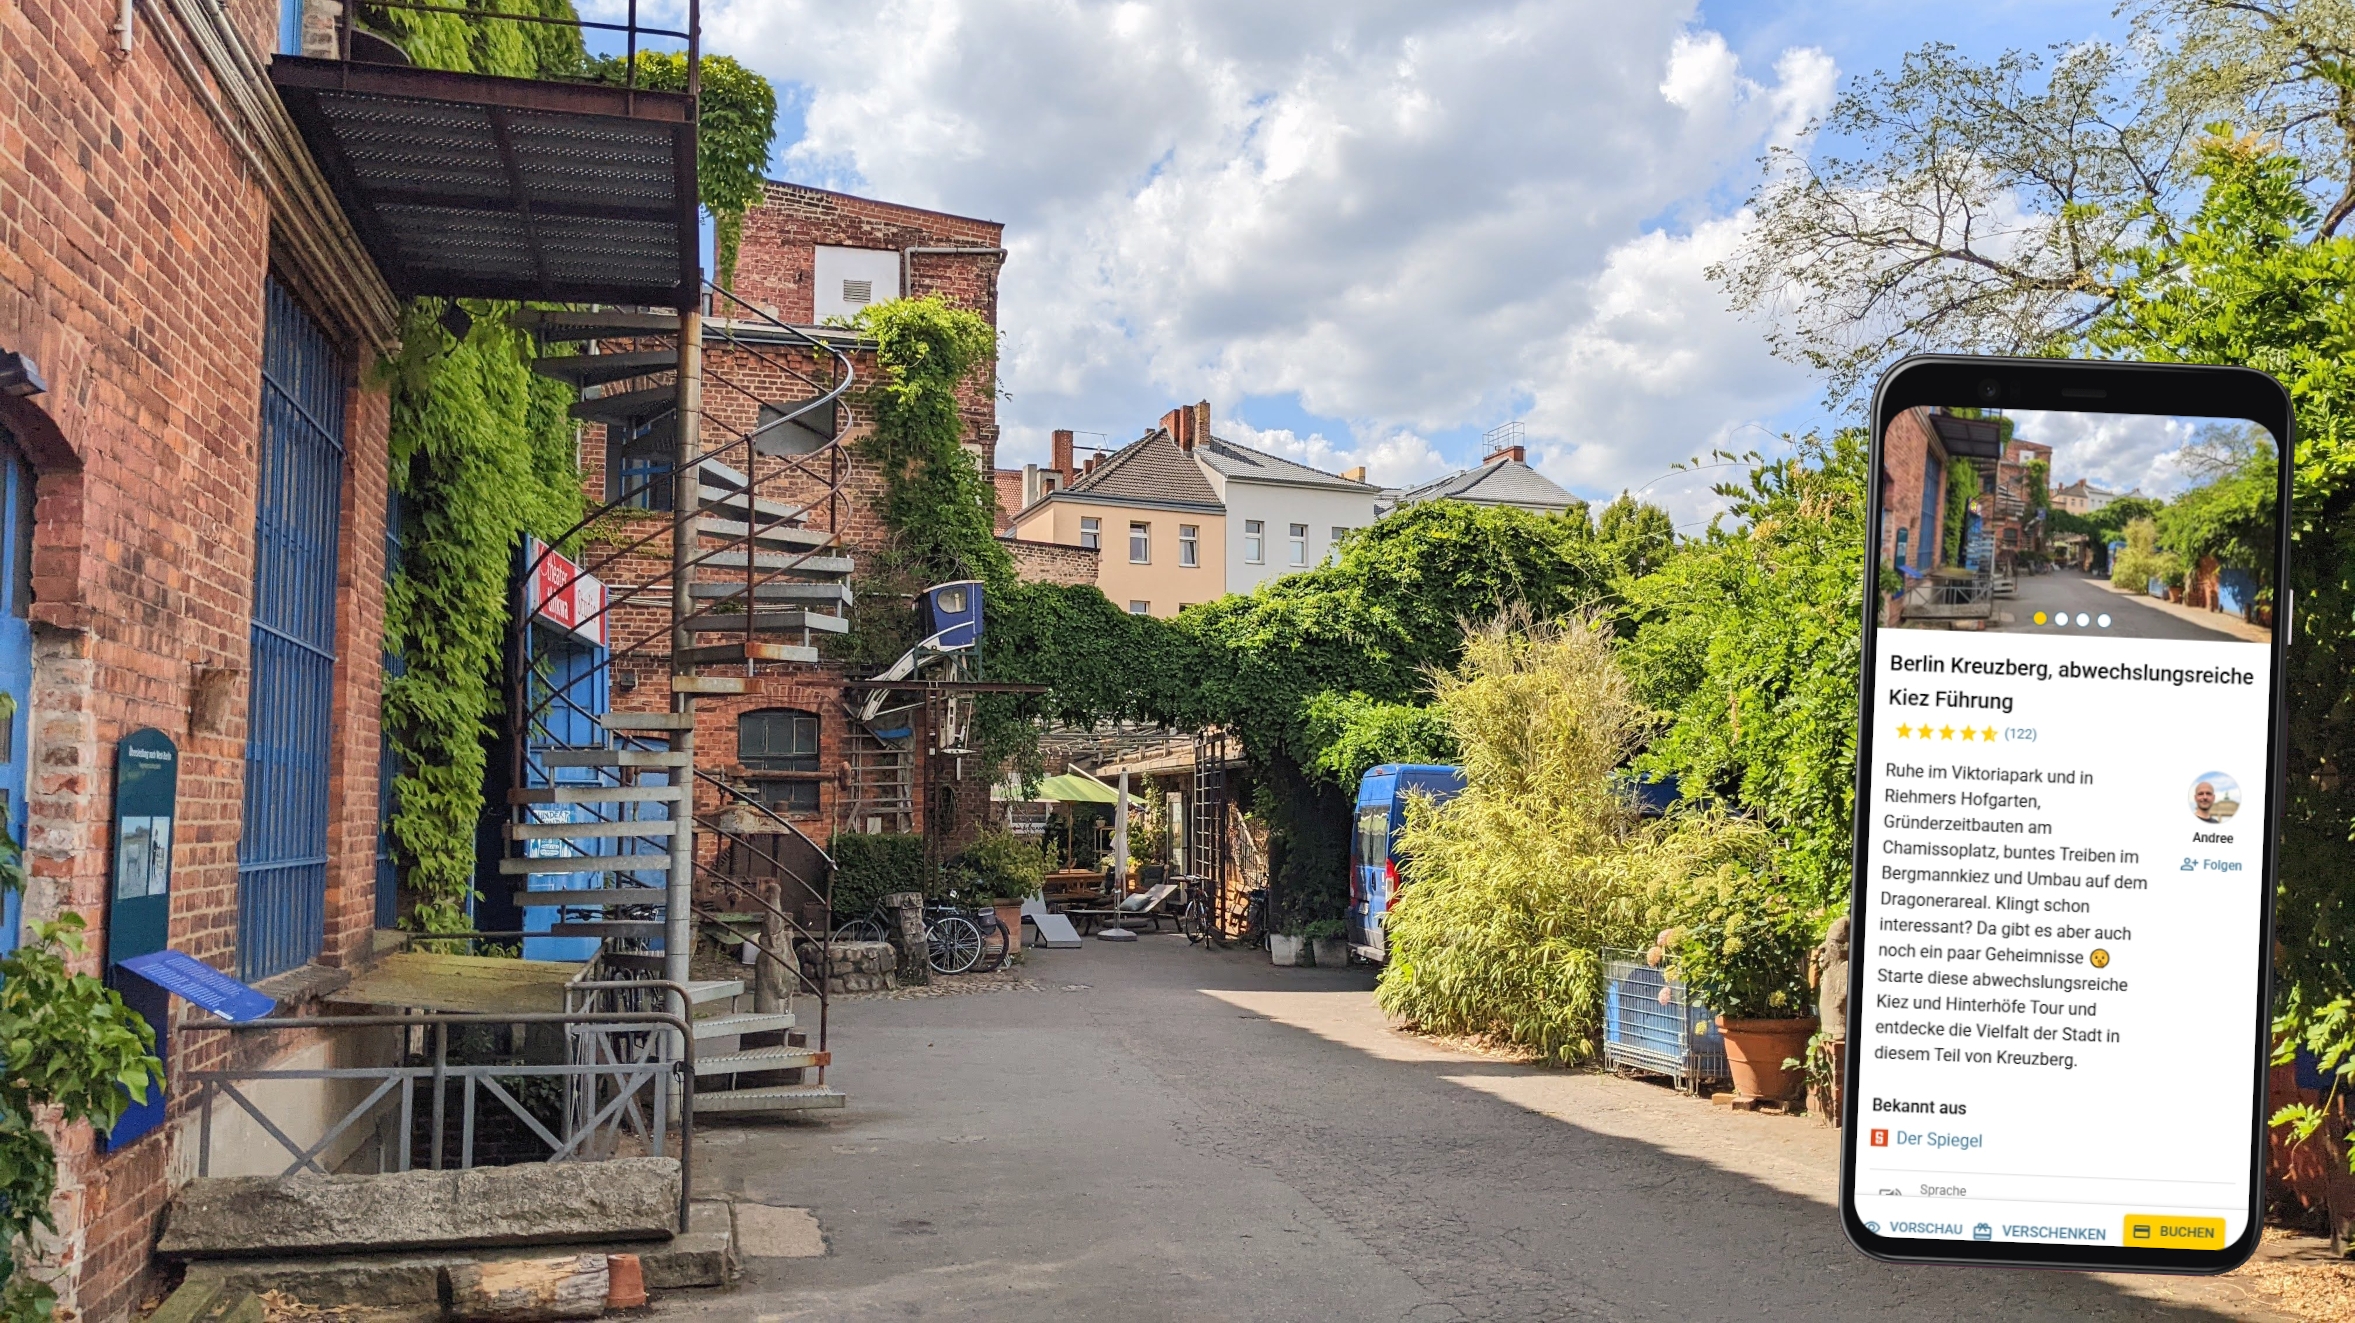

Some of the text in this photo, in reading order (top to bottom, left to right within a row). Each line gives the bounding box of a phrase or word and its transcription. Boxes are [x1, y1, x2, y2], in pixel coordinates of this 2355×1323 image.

[546, 553, 568, 587] theater
[1891, 655, 2254, 686] Berlin Kreuzberg, abwechslungsreiche
[1889, 688, 2013, 713] Kiez Führung
[2004, 727, 2037, 741] (122)
[1886, 763, 2093, 784] Ruhe im Viktoriapark und in
[1885, 789, 2040, 810] Riehmers Hofgarten,
[1884, 815, 2051, 834] Gründerzeitbauten am
[2193, 832, 2233, 843] Andree
[1883, 840, 2138, 863] Chamissoplatz, buntes Treiben im
[2204, 859, 2242, 872] Folgen
[1882, 866, 2148, 889] Bergmannkiez und Umbau auf dem
[1881, 891, 2089, 913] Dragonerareal. Klingt schon
[1880, 917, 2131, 940] interessant? Da gibt es aber auch
[1879, 944, 2083, 964] noch ein paar Geheimnisse
[1878, 969, 2127, 992] Starte diese abwechslungsreiche
[1877, 994, 2096, 1016] Kiez und Hinterhöfe Tour und
[1876, 1021, 2119, 1042] entdecke die Vielfalt der Stadt in
[1875, 1046, 2077, 1069] diesem Teil von Kreuzberg.
[1873, 1098, 1966, 1115] Bekannt aus
[1897, 1131, 1982, 1150] Der Spiegel
[1920, 1185, 1967, 1197] Sprache
[1890, 1221, 1963, 1235] VORSCHAU
[2003, 1225, 2105, 1240] VERSCHENKEN
[2160, 1225, 2215, 1239] BUCHEN
